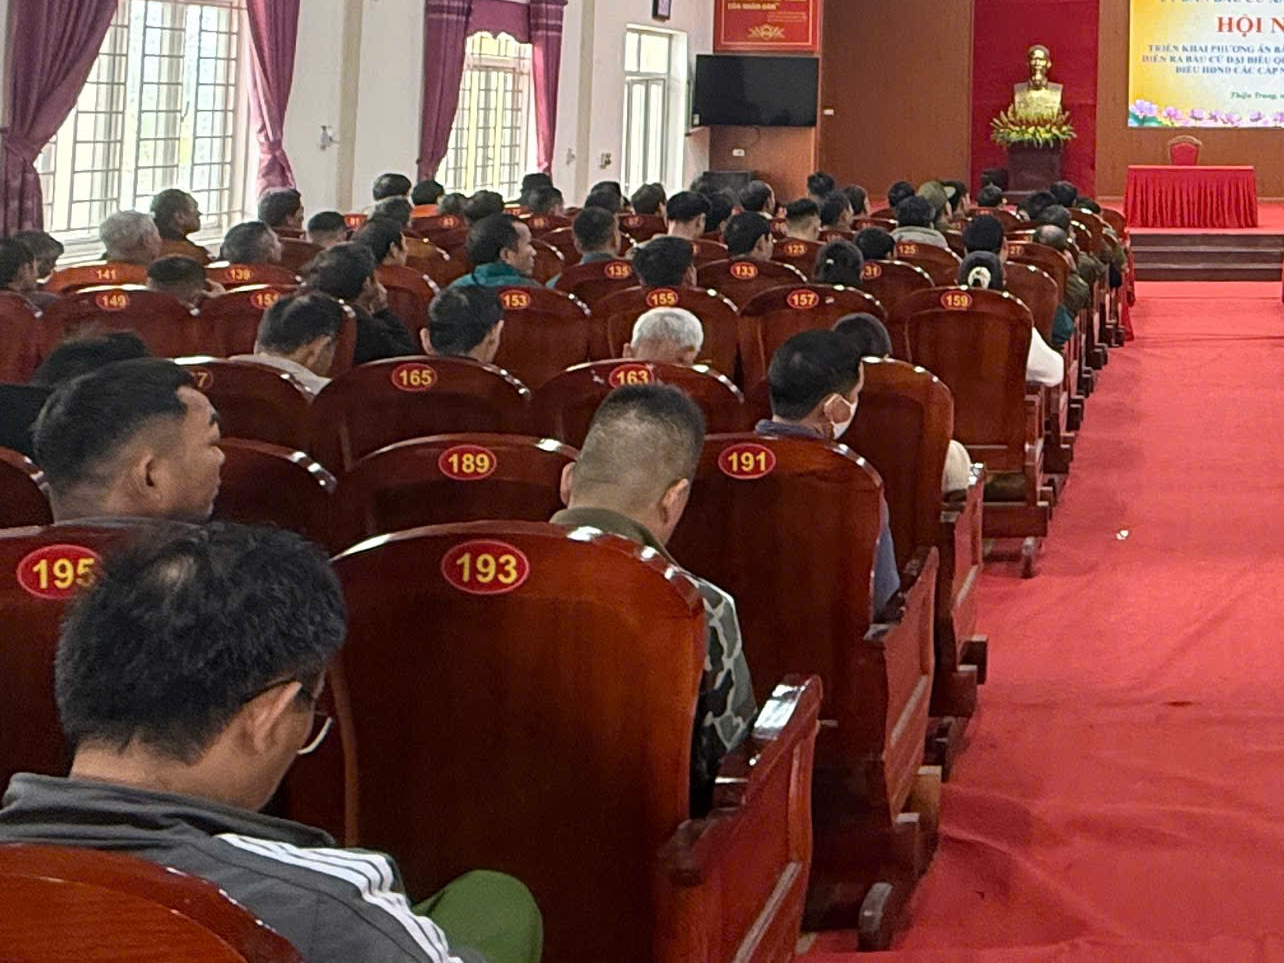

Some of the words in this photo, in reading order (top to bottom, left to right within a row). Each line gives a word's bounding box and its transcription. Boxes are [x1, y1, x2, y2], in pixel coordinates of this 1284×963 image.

[1217, 13, 1263, 37] HỘI
[787, 244, 804, 254] 123
[96, 269, 116, 280] 141
[735, 265, 755, 277] 133
[864, 266, 878, 277] 31
[102, 294, 126, 309] 149
[503, 294, 527, 306] 153
[651, 292, 675, 305] 155
[792, 293, 815, 306] 157
[946, 293, 967, 306] 159
[399, 370, 433, 386] 165
[616, 369, 649, 385] 163
[448, 453, 489, 473] 189
[728, 452, 766, 472] 191
[33, 557, 96, 590] 195
[456, 552, 518, 584] 193
